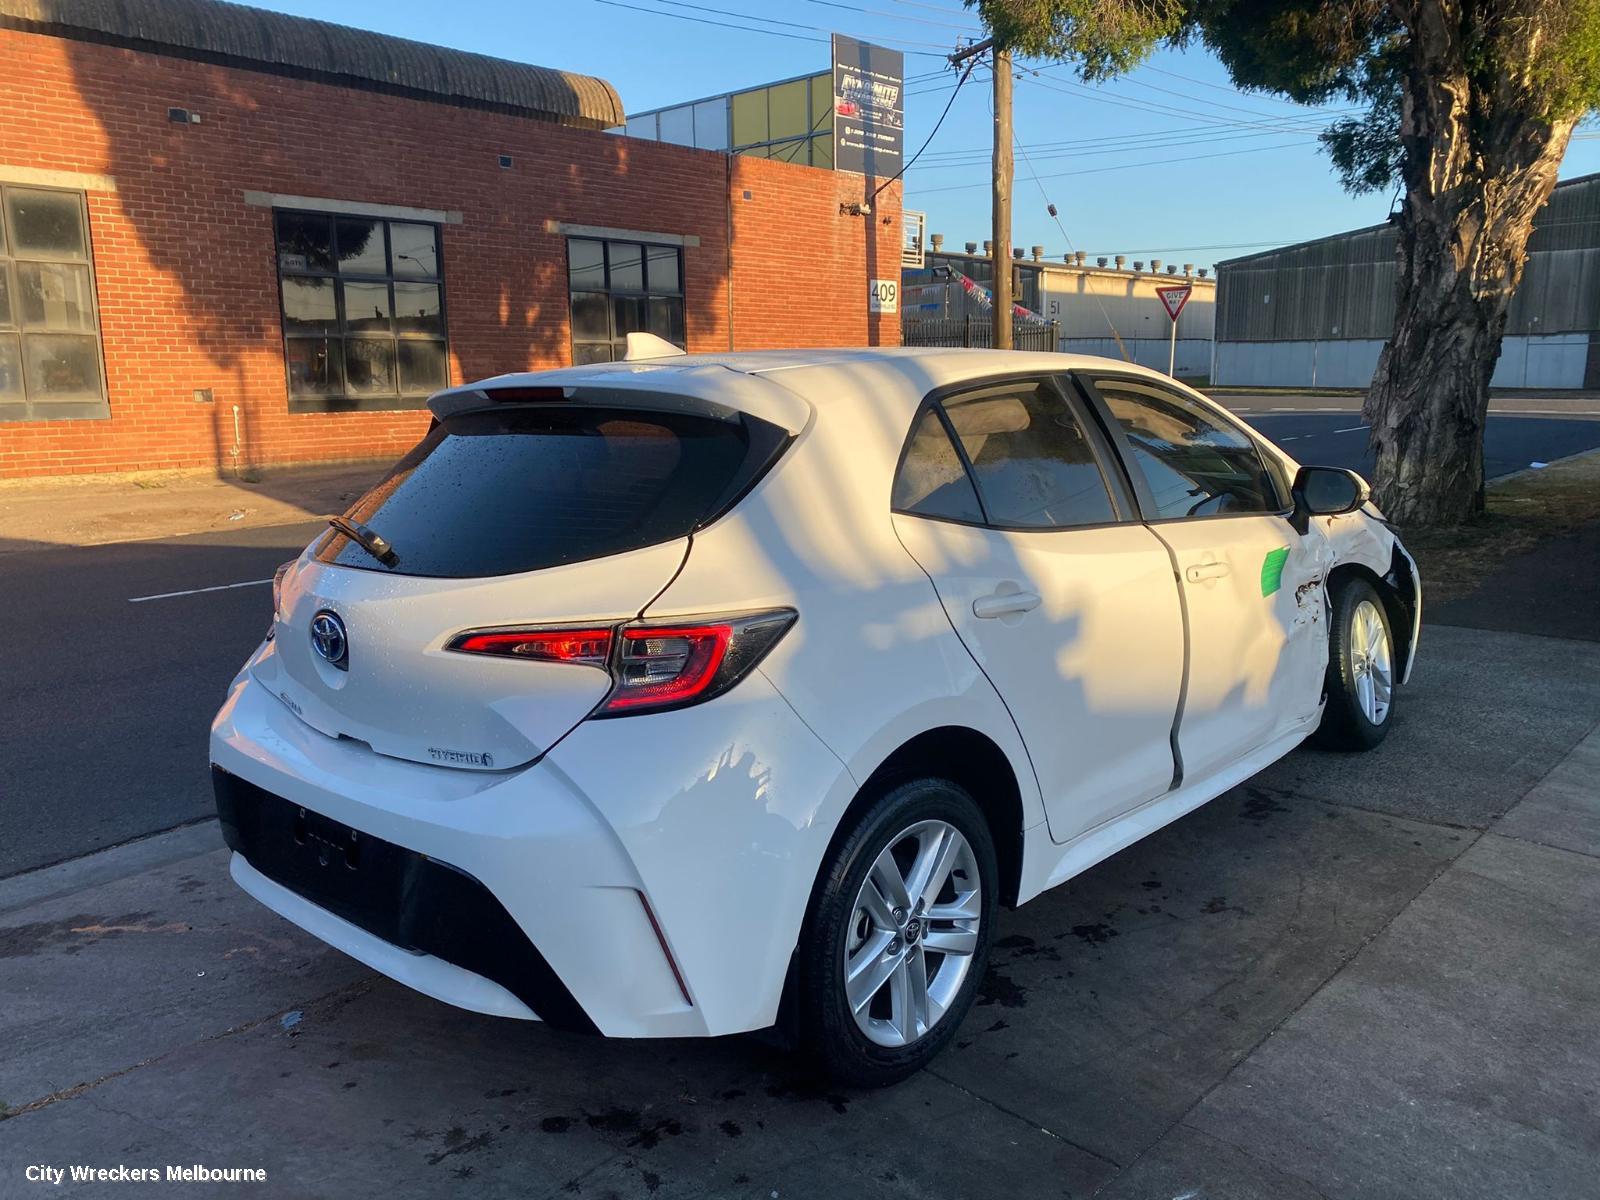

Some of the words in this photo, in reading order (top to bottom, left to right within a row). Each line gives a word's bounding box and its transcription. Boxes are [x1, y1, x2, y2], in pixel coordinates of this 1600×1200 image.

[871, 283, 896, 302] 409
[1166, 291, 1184, 299] GIVE
[1050, 300, 1060, 314] 51
[430, 747, 485, 765] HYBRID
